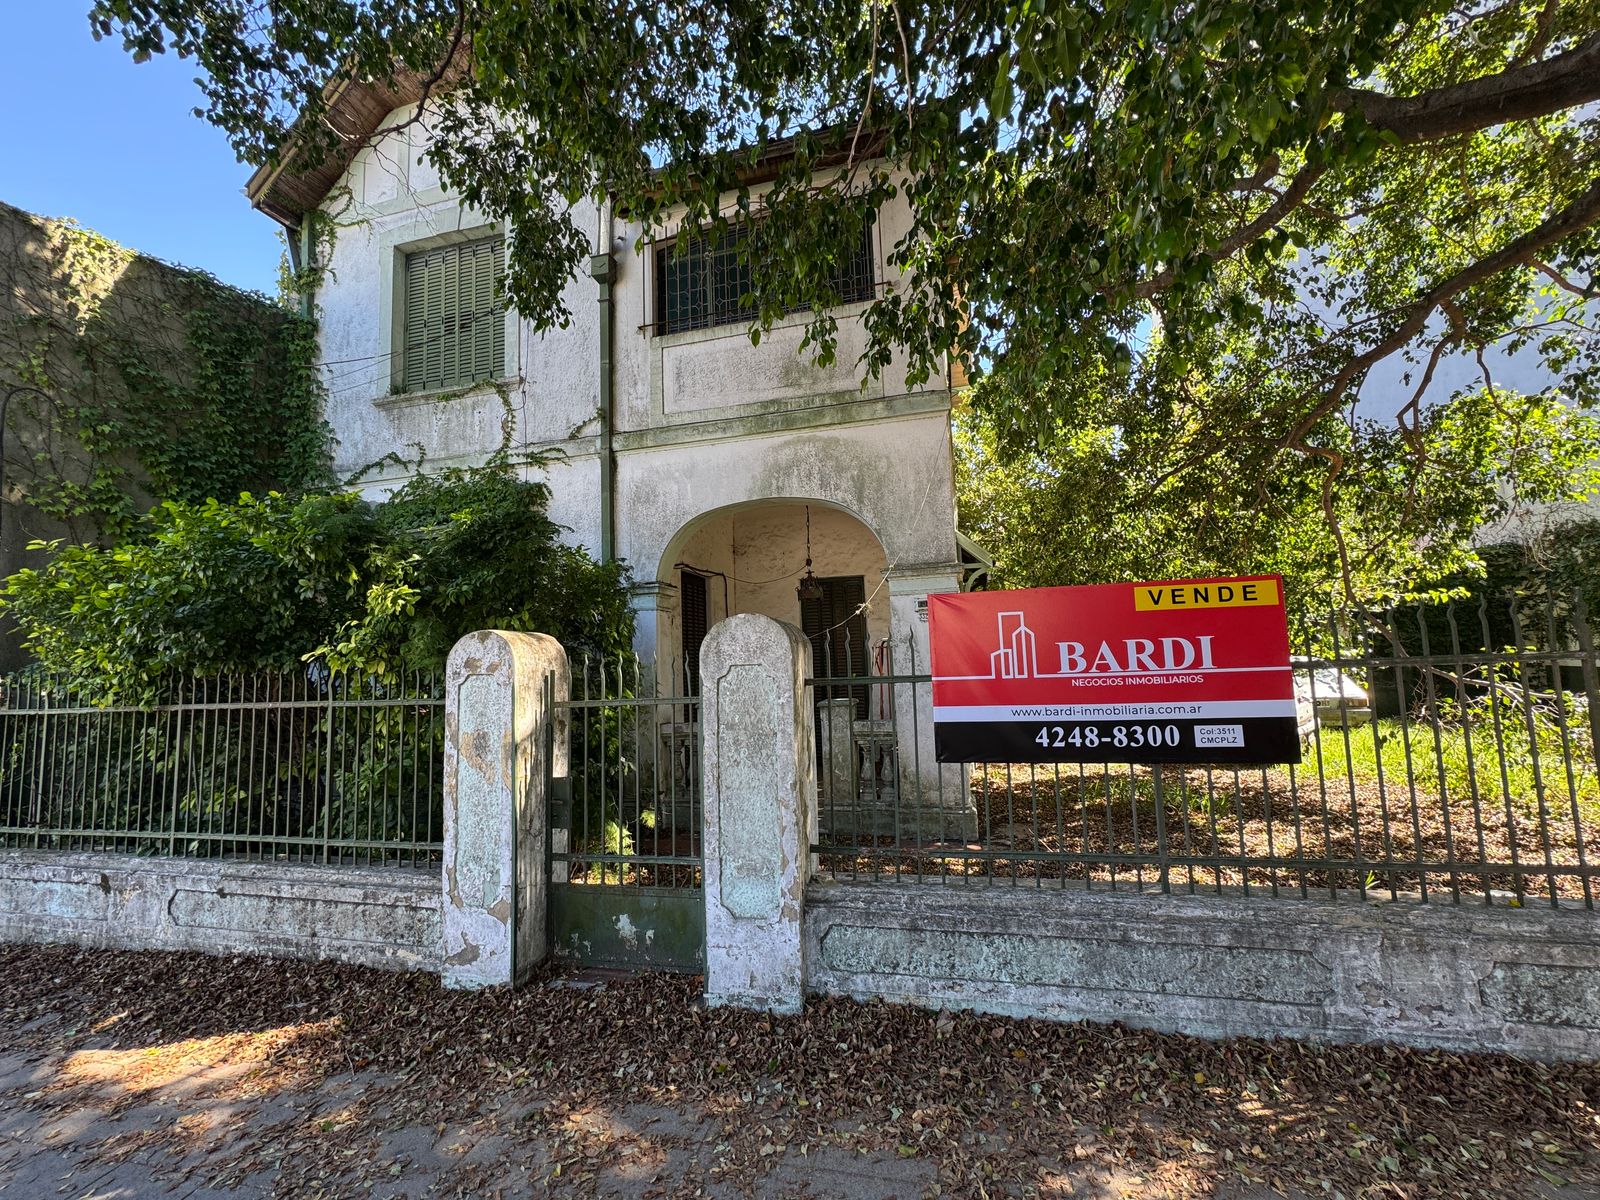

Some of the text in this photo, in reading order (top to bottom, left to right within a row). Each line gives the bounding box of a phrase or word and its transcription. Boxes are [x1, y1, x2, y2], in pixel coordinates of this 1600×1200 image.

[1148, 584, 1258, 606] VENDE
[1055, 635, 1218, 674] BARDI
[1071, 674, 1204, 687] NEGOCIOS INMOBILIARIOS
[1011, 704, 1203, 717] www.bardi-inmobiliaria.com.ar
[1035, 724, 1181, 748] 4248-8300
[1199, 727, 1237, 736] Col:3511
[1200, 735, 1238, 744] CMCPLZ
